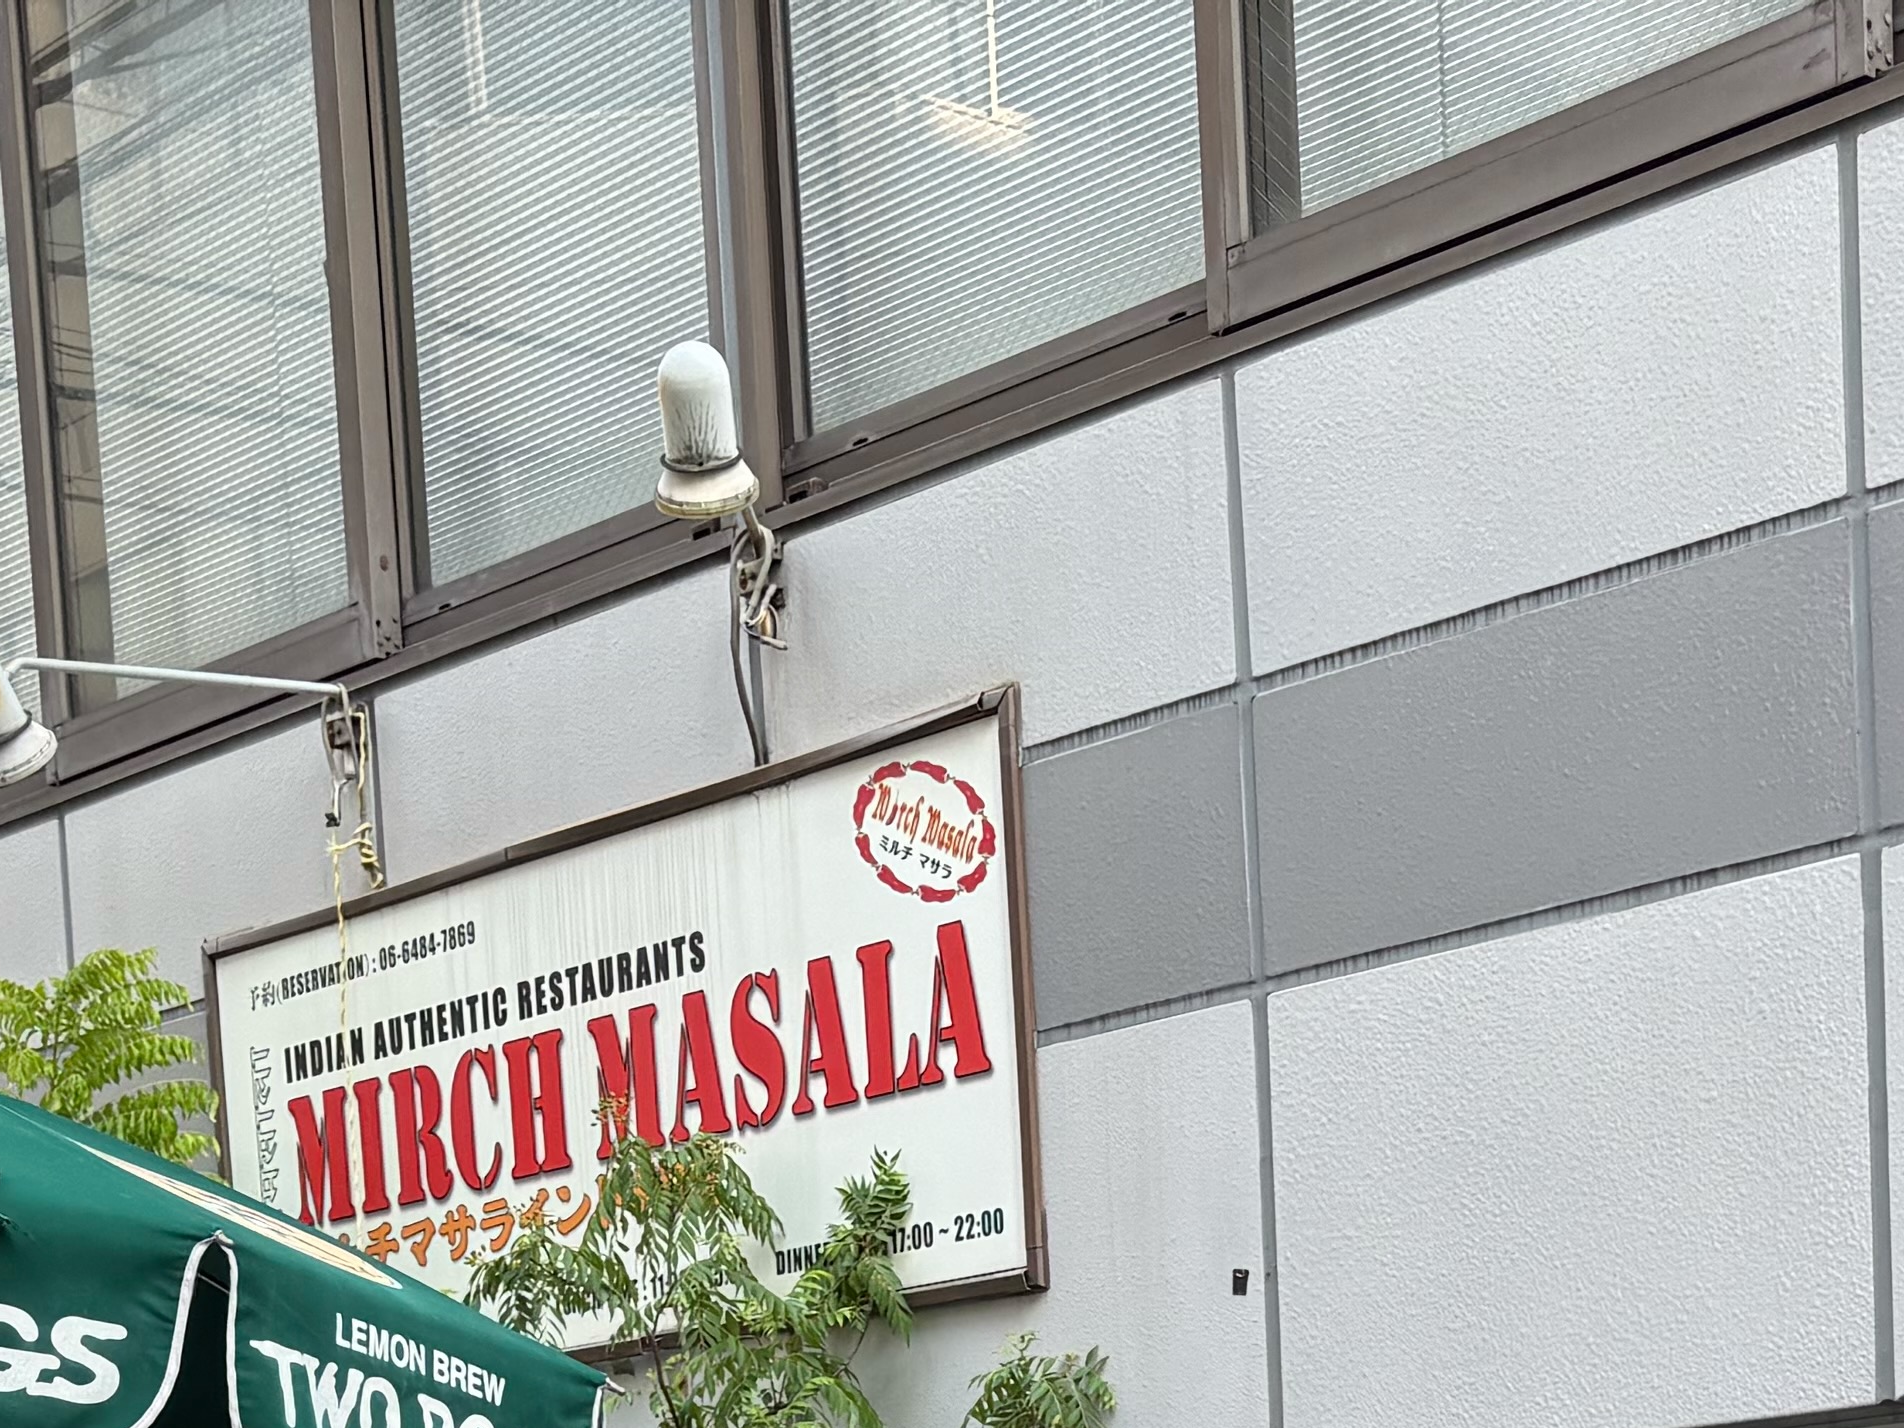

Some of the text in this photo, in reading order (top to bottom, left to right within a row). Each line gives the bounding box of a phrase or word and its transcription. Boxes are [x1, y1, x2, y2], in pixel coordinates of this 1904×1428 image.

[379, 920, 477, 970] 06-6484-7869
[284, 930, 706, 1084] INDIAN AUTHENTIC RESTAURANTS
[287, 1028, 572, 1225] MIRCH
[587, 919, 993, 1161] MASALA
[953, 1207, 1005, 1241] 22:00
[333, 1312, 507, 1408] LEMON BREW
